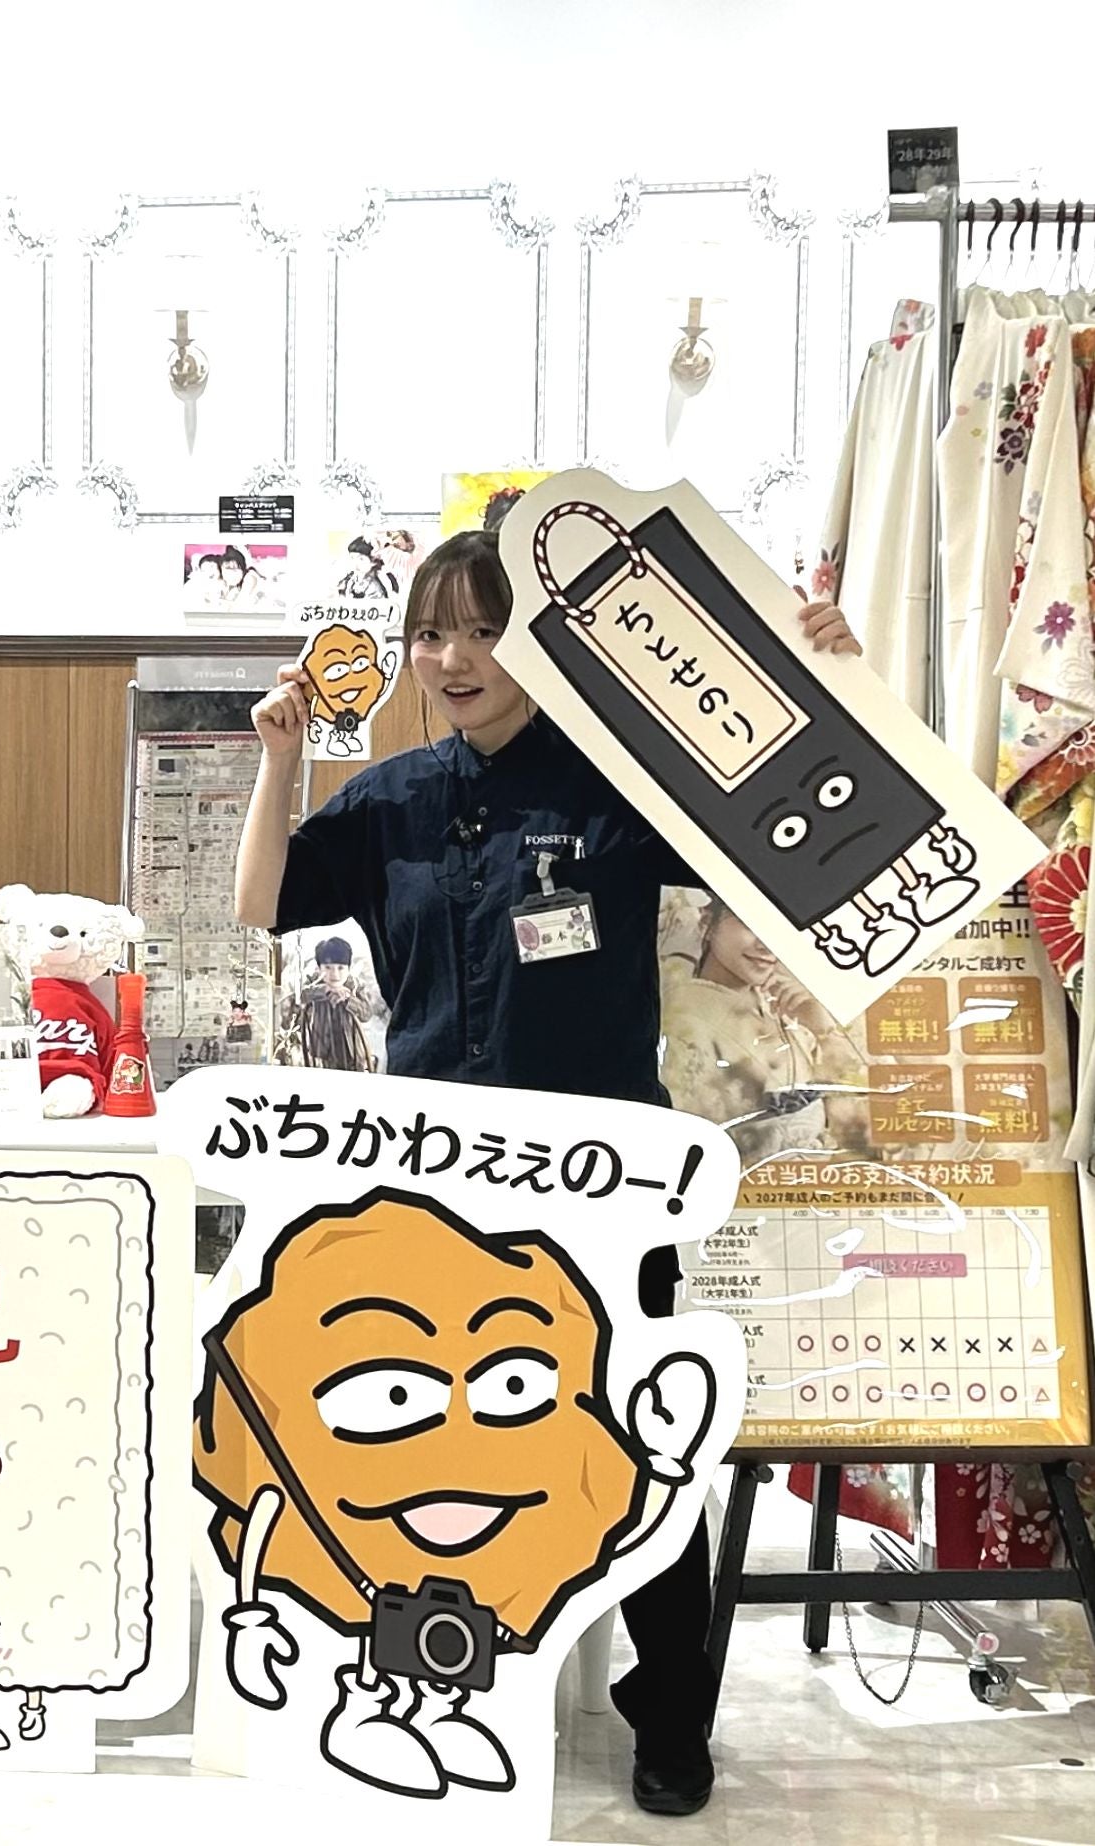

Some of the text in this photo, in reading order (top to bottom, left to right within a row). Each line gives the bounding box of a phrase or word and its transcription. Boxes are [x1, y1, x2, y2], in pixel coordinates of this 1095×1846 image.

[615, 601, 753, 743] ちとせのり
[878, 1018, 939, 1043] 無料!
[974, 1020, 1033, 1043] 無料!
[873, 1117, 953, 1132] フルセット!
[980, 1110, 1039, 1133] 無料!
[704, 1239, 750, 1248] 大学2年生)
[692, 1276, 761, 1286] 2028年成人式
